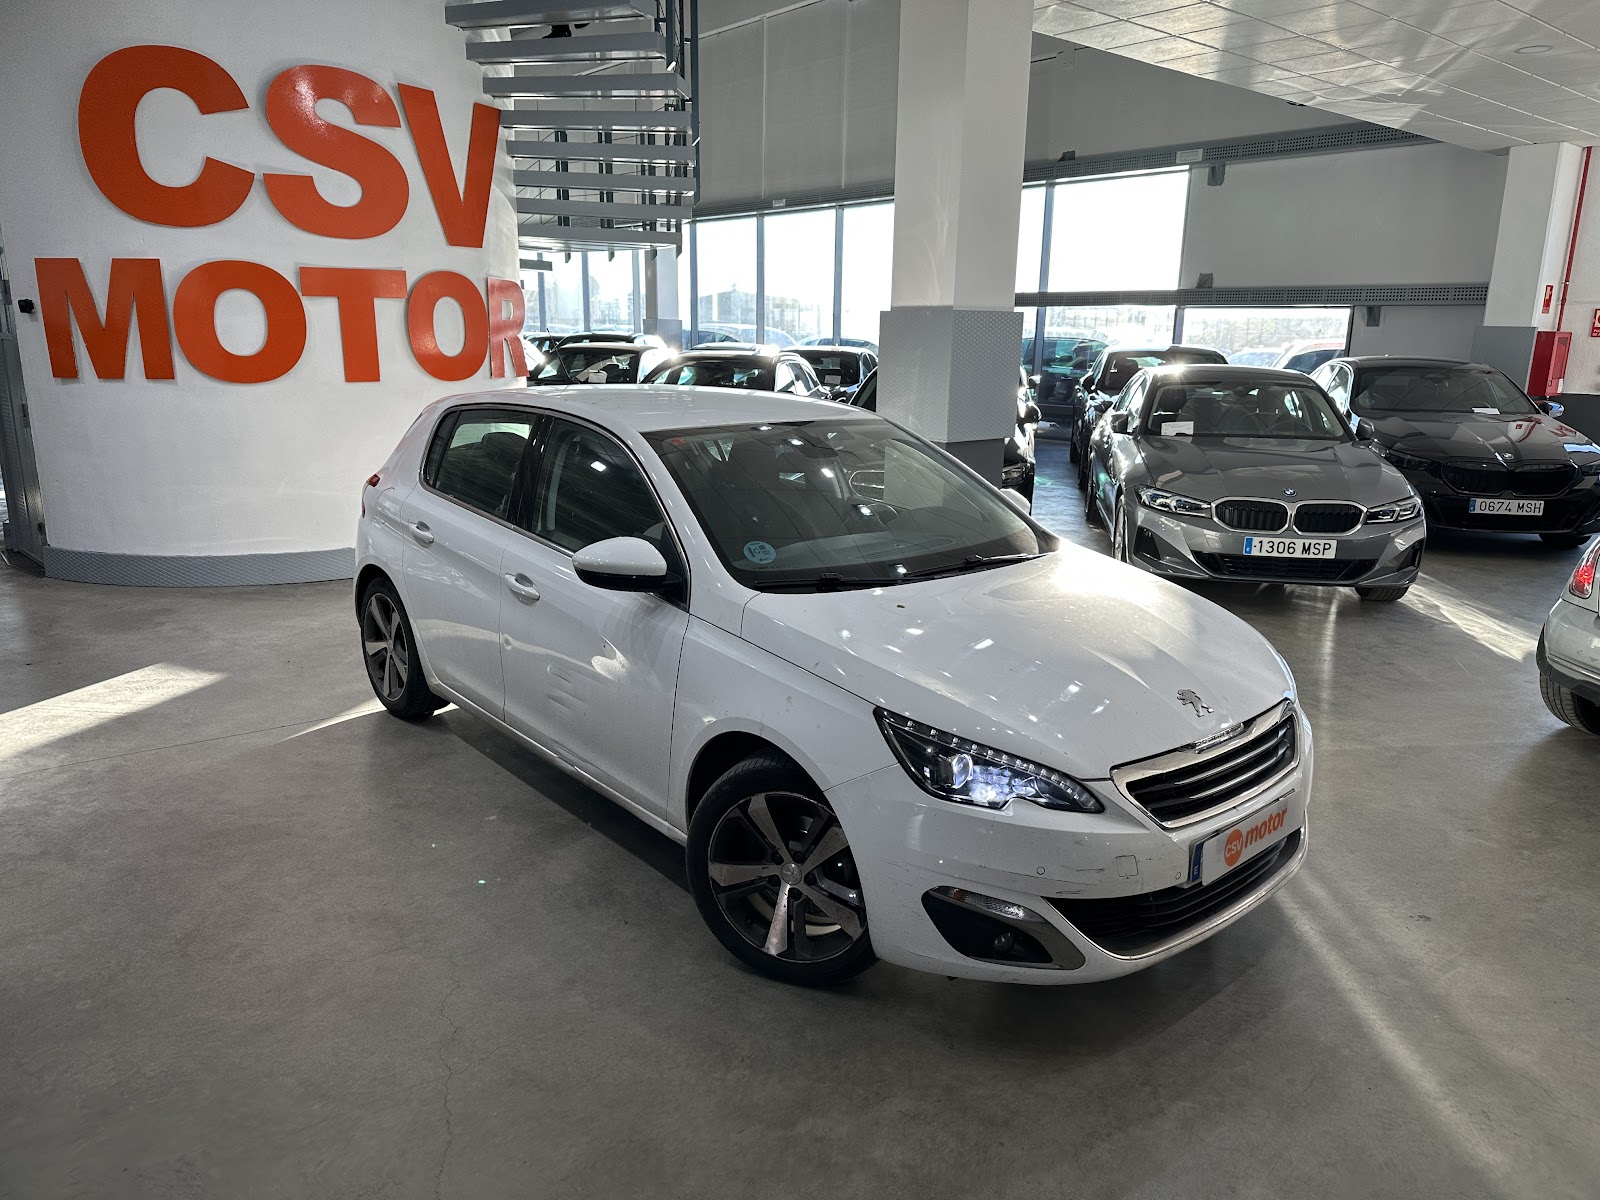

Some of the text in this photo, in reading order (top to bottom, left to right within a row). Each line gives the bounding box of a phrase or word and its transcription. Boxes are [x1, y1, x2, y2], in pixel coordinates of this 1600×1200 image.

[78, 45, 501, 249] CSV
[34, 257, 530, 384] MOTOR
[1479, 501, 1542, 514] 0674 MSH
[1258, 540, 1332, 556] 1306 MSP
[1244, 807, 1288, 849] motor
